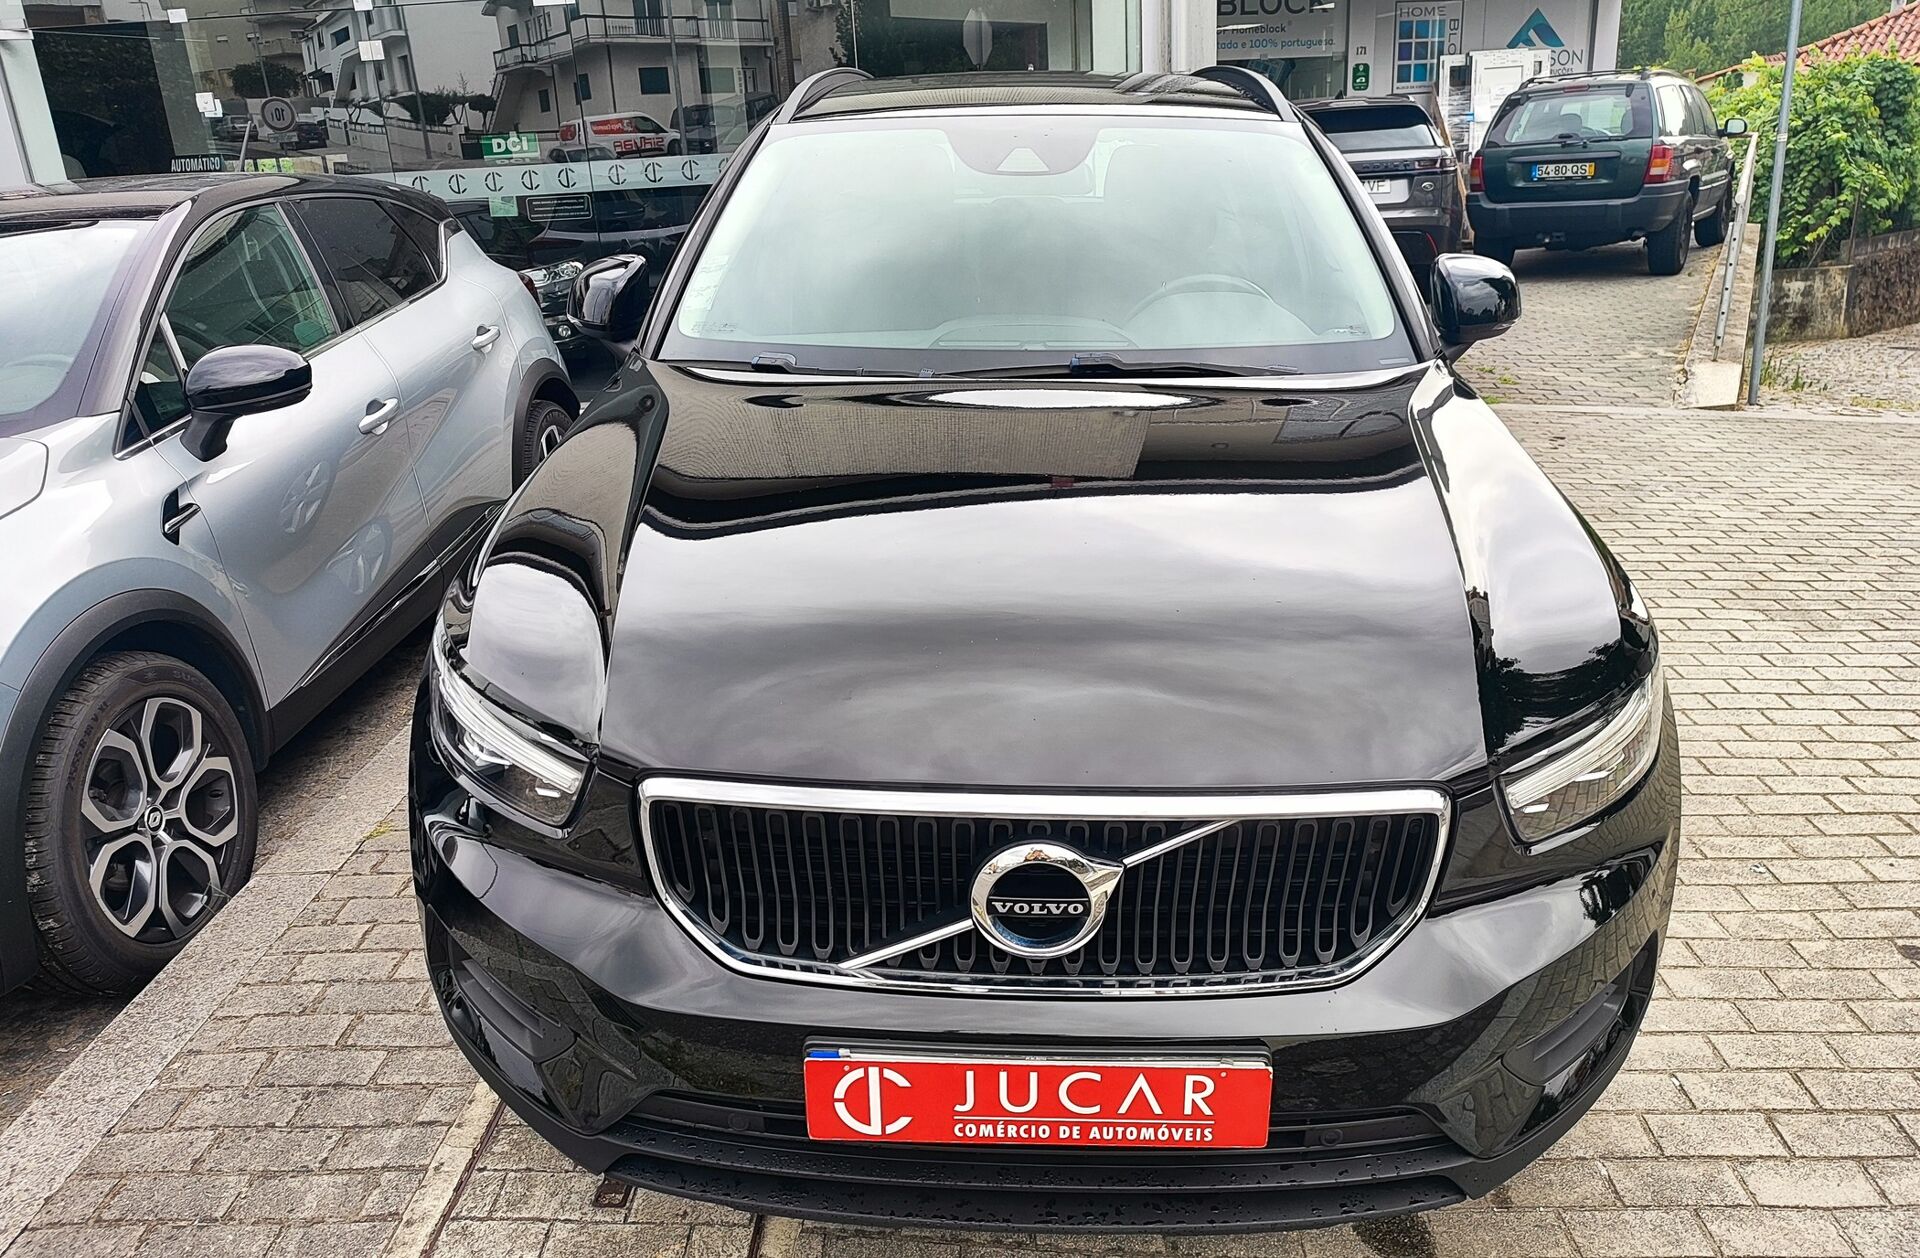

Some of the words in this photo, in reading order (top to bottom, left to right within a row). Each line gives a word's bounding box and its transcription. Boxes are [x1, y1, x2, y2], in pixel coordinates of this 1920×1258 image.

[1400, 6, 1447, 17] HOME
[1250, 38, 1277, 49] 100%
[491, 136, 529, 153] DCI
[171, 156, 221, 172] AUTOMÁTICO
[991, 901, 1084, 915] VOLVO
[953, 1069, 1215, 1116] JUCAR
[953, 1121, 1051, 1140] COMÉRCIO
[1059, 1126, 1081, 1140] DE
[1088, 1122, 1214, 1142] AUTOMÓVEIS
